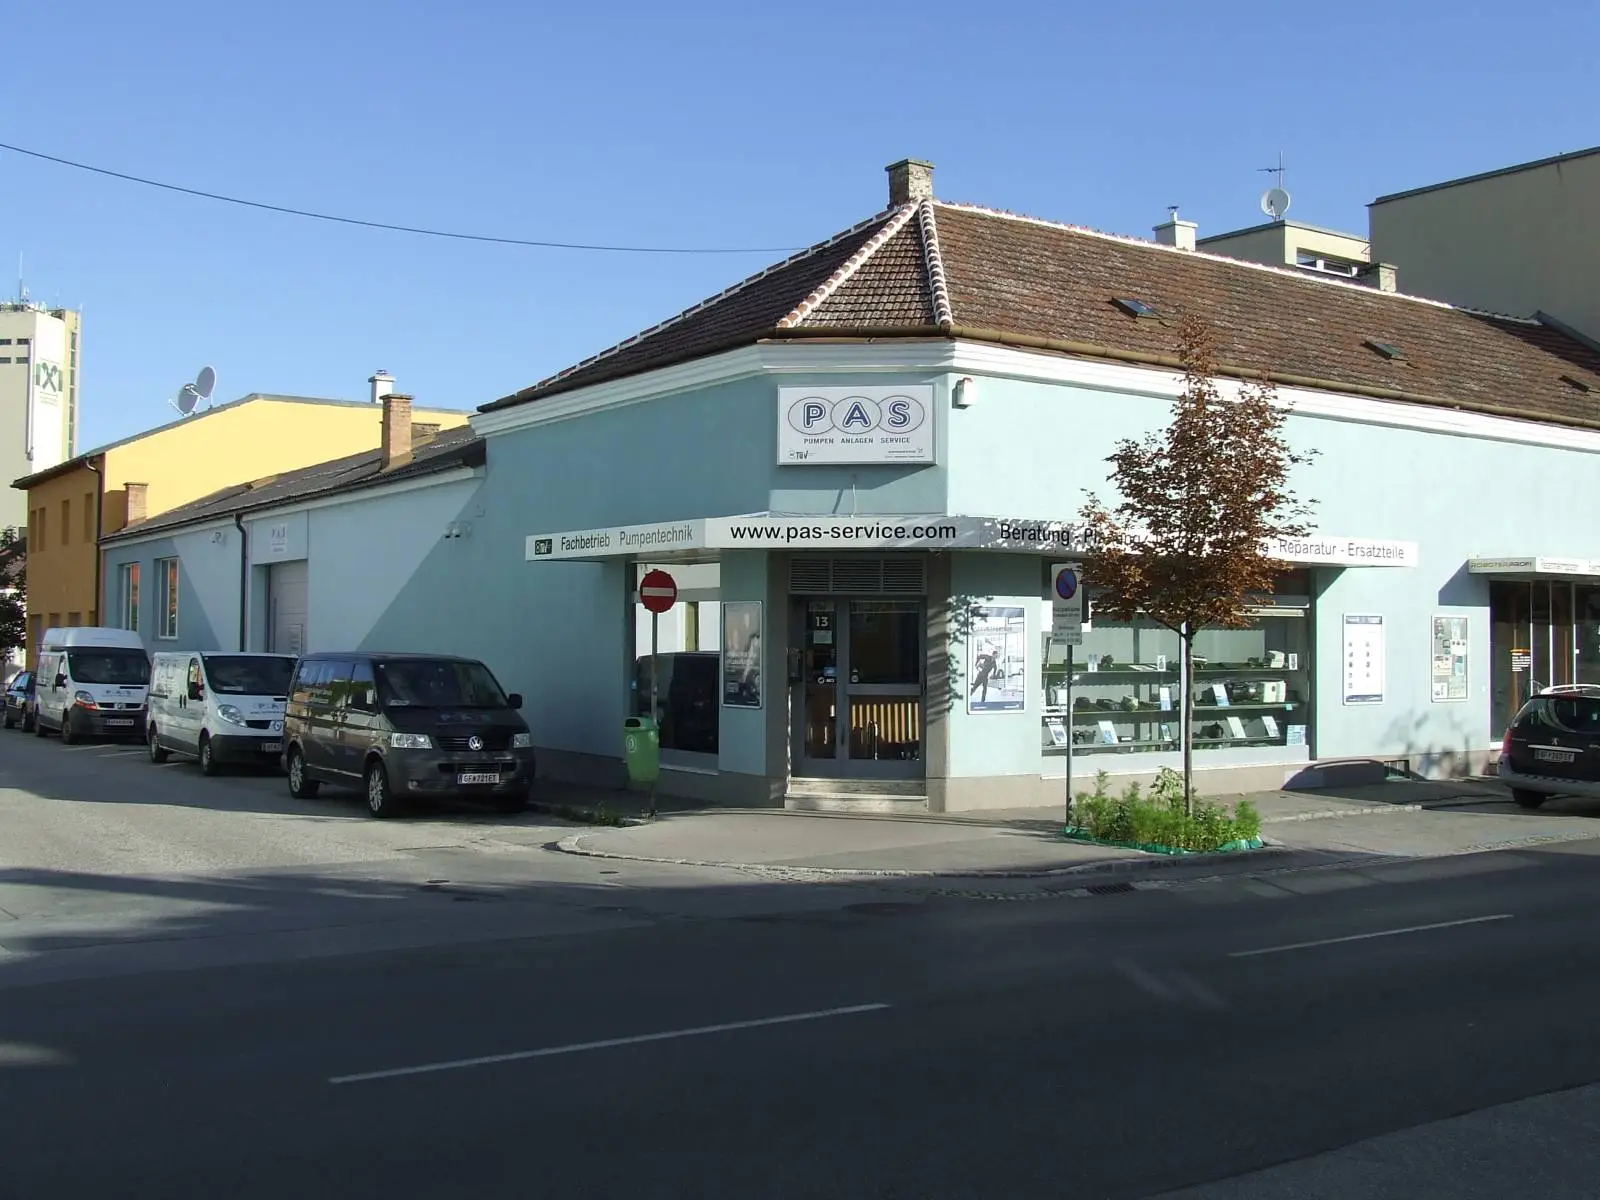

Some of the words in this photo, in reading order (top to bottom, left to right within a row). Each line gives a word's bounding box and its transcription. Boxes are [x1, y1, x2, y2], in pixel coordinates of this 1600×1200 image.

[804, 437, 834, 445] PUMPEN
[880, 436, 910, 444] SERVICE
[560, 532, 610, 551] Fachbetrieb
[619, 524, 693, 548] Pumpentechnik
[730, 522, 957, 543] www.pas-service.com
[1000, 523, 1070, 546] Beratung
[1279, 538, 1336, 558] Reparatur
[1348, 543, 1405, 559] Ersatzteile
[816, 616, 829, 627] 13
